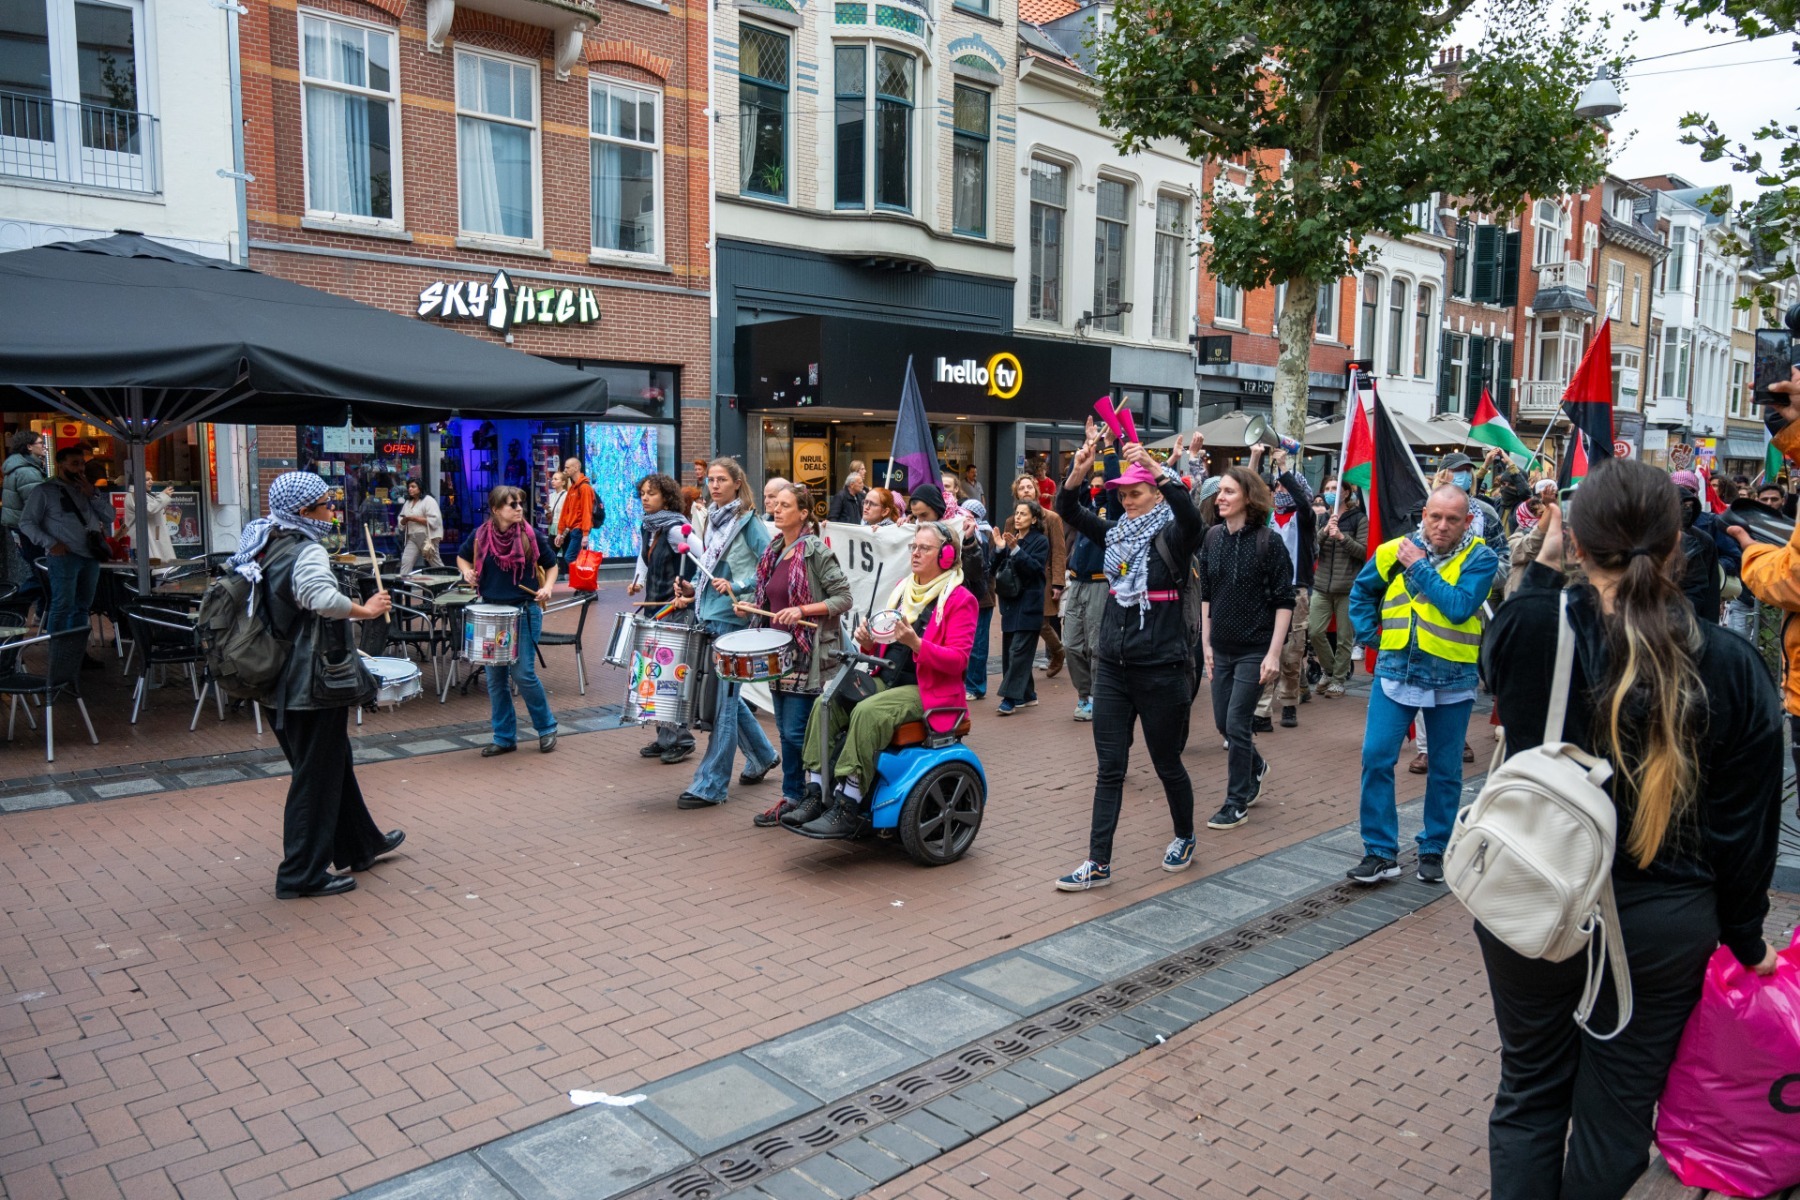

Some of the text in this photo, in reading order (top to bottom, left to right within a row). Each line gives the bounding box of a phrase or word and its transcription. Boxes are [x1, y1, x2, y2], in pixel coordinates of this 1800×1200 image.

[417, 281, 601, 324] SKY HIGH
[936, 357, 1017, 387] hello tv
[1243, 381, 1257, 392] TER
[383, 444, 415, 454] OPEN
[800, 455, 824, 463] INRUIL
[803, 463, 827, 471] DEALS
